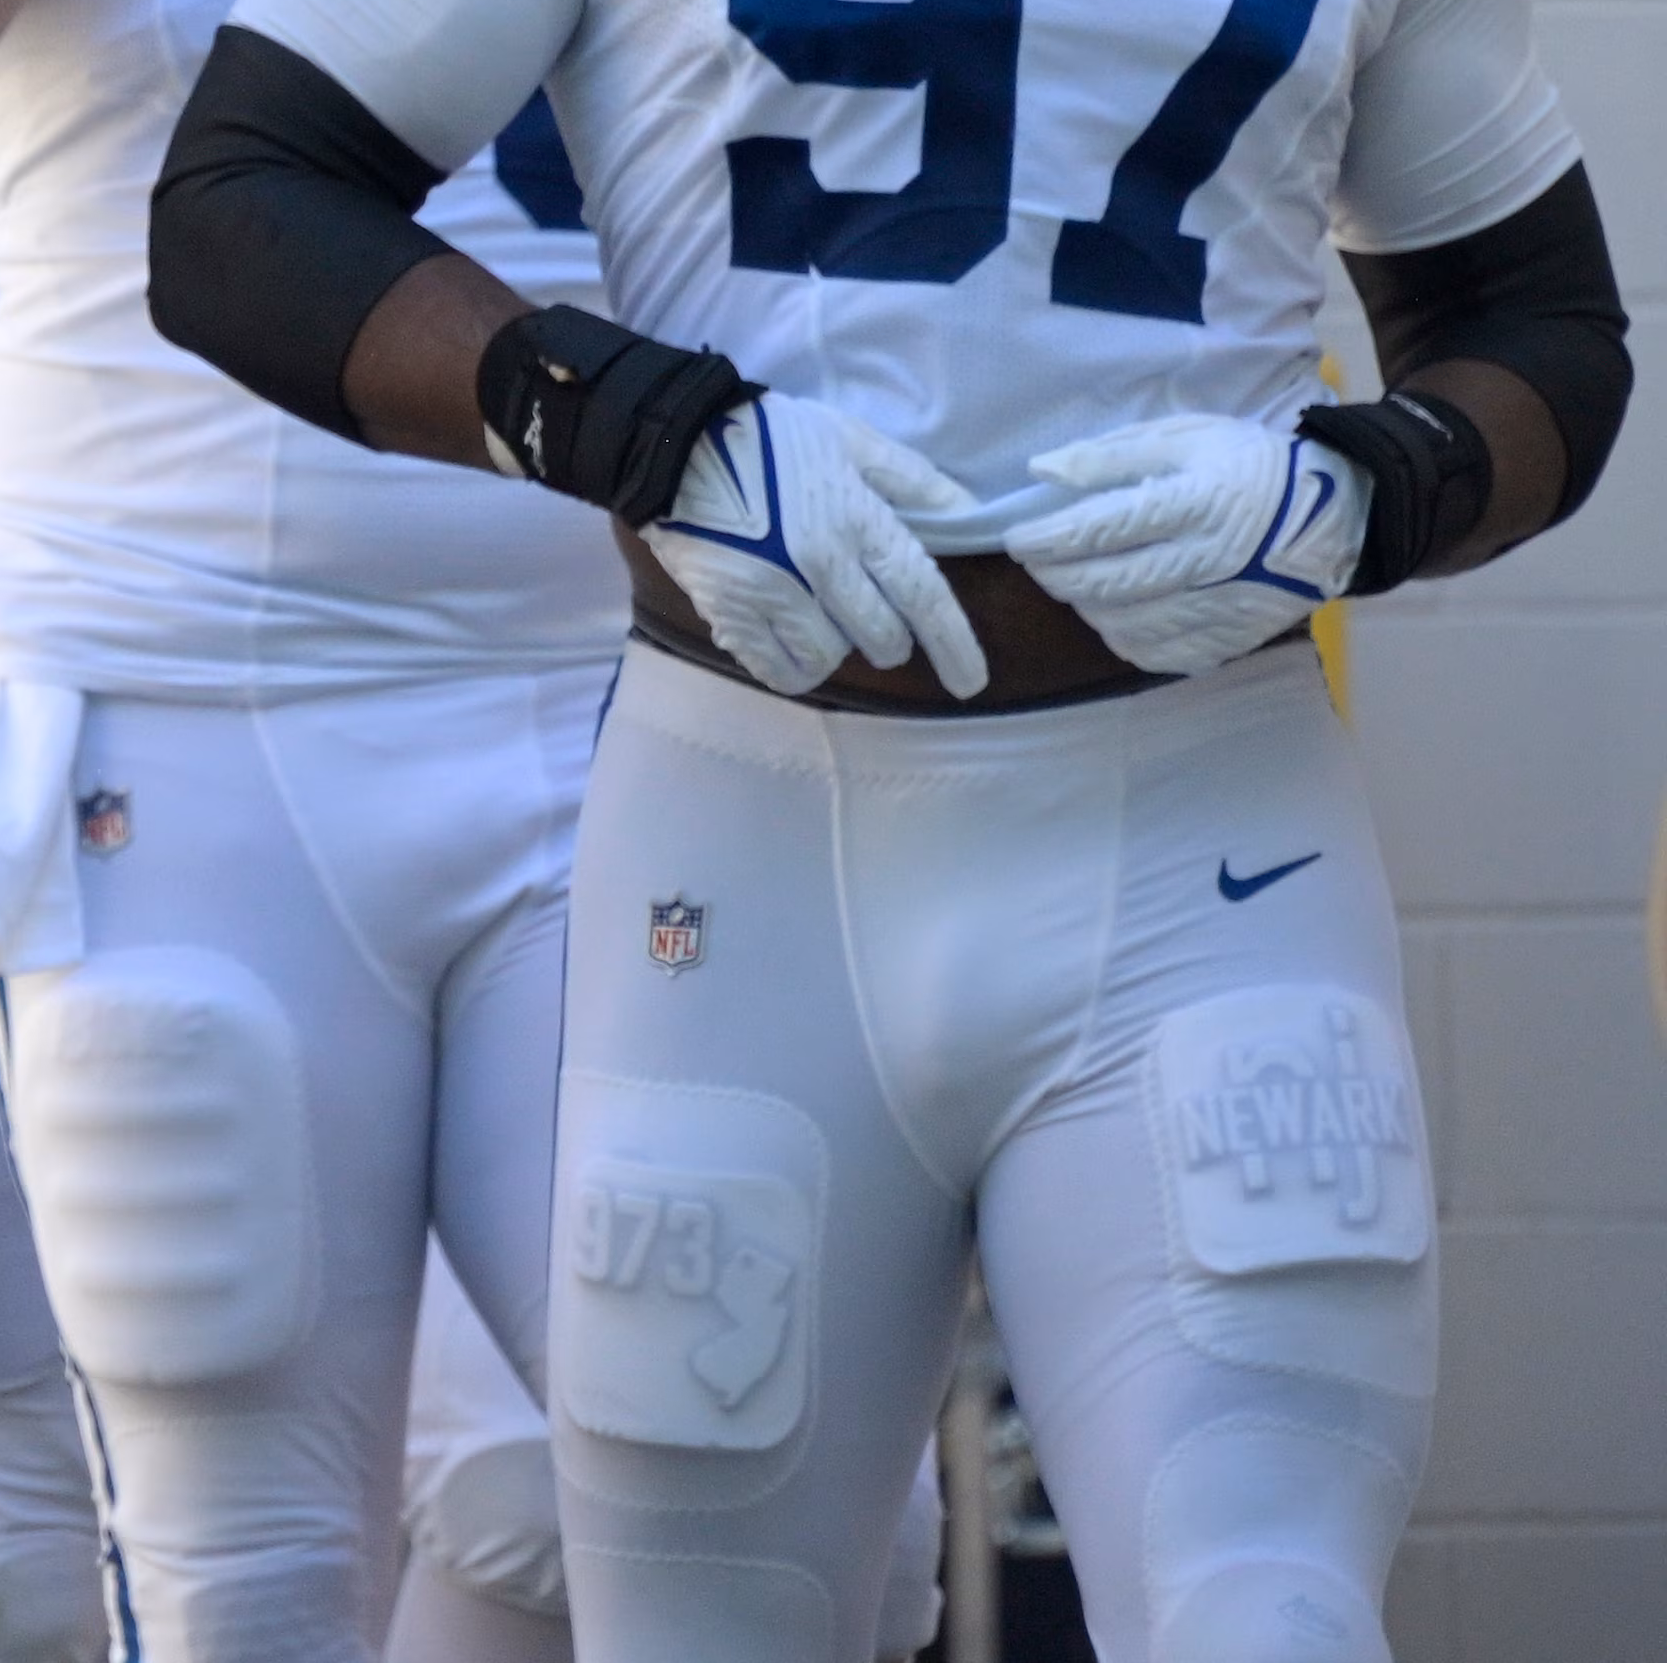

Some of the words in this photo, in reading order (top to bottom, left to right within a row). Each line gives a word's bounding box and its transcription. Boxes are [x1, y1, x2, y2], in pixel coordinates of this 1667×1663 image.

[656, 929, 697, 958] NFL
[1175, 1081, 1411, 1165] NEWARK
[570, 1187, 714, 1299] 973
